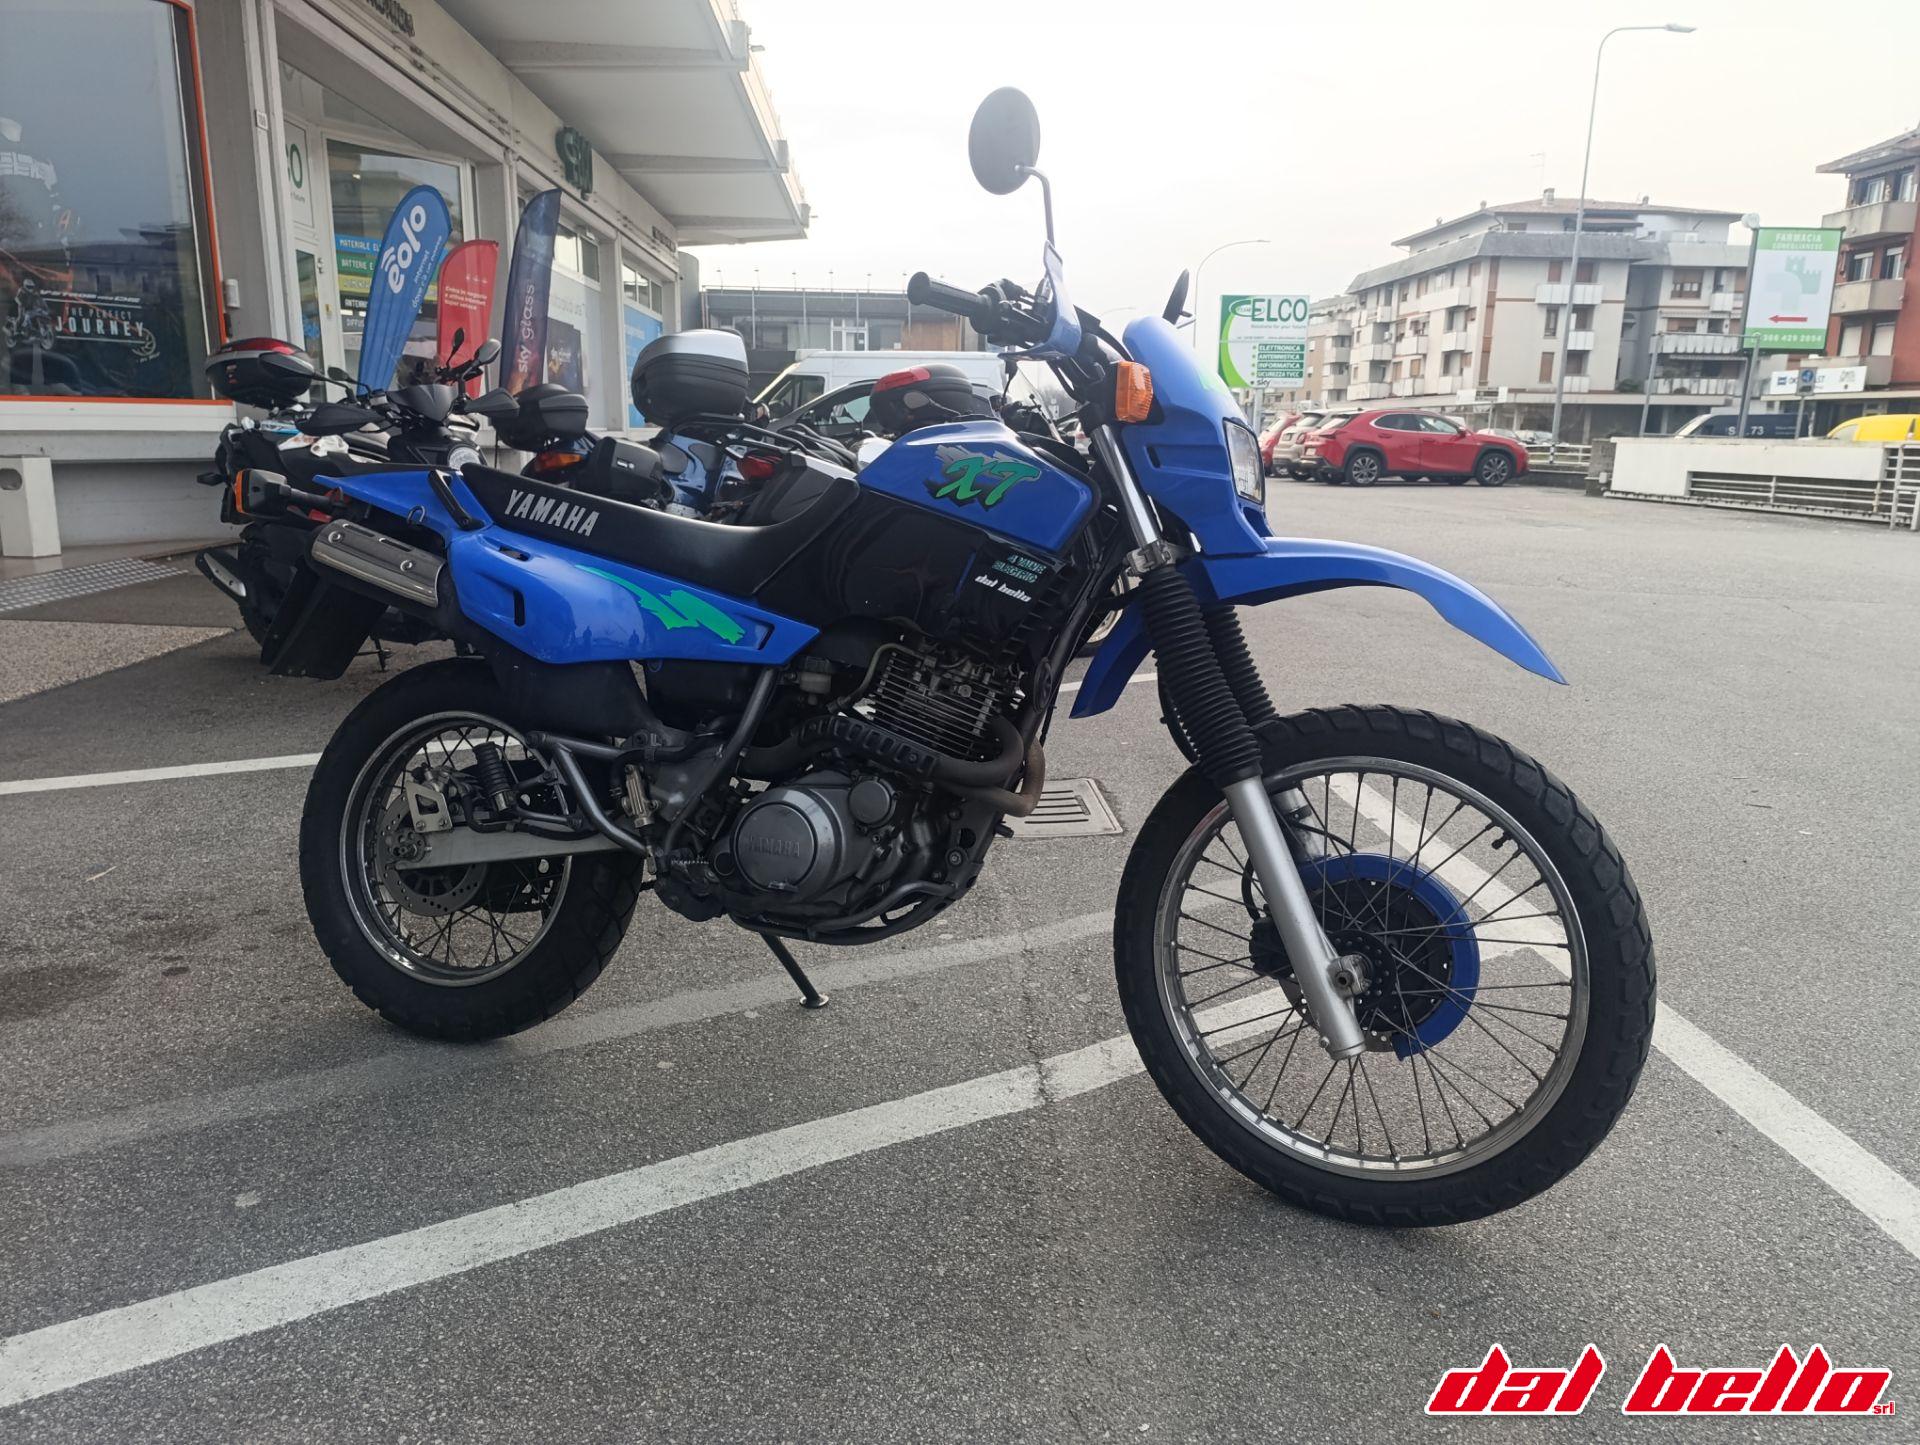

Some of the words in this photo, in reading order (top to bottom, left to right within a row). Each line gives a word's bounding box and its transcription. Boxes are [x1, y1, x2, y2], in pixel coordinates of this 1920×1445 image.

[384, 205, 427, 294] eolo
[1775, 233, 1822, 242] FARMACIA
[520, 284, 535, 340] glass
[1251, 298, 1308, 323] ELCO
[55, 316, 144, 337] JOURNEY
[517, 345, 532, 373] sky
[935, 456, 1042, 506] XT
[504, 489, 600, 537] YAMAHA
[975, 573, 999, 588] dal
[997, 583, 1032, 603] bello
